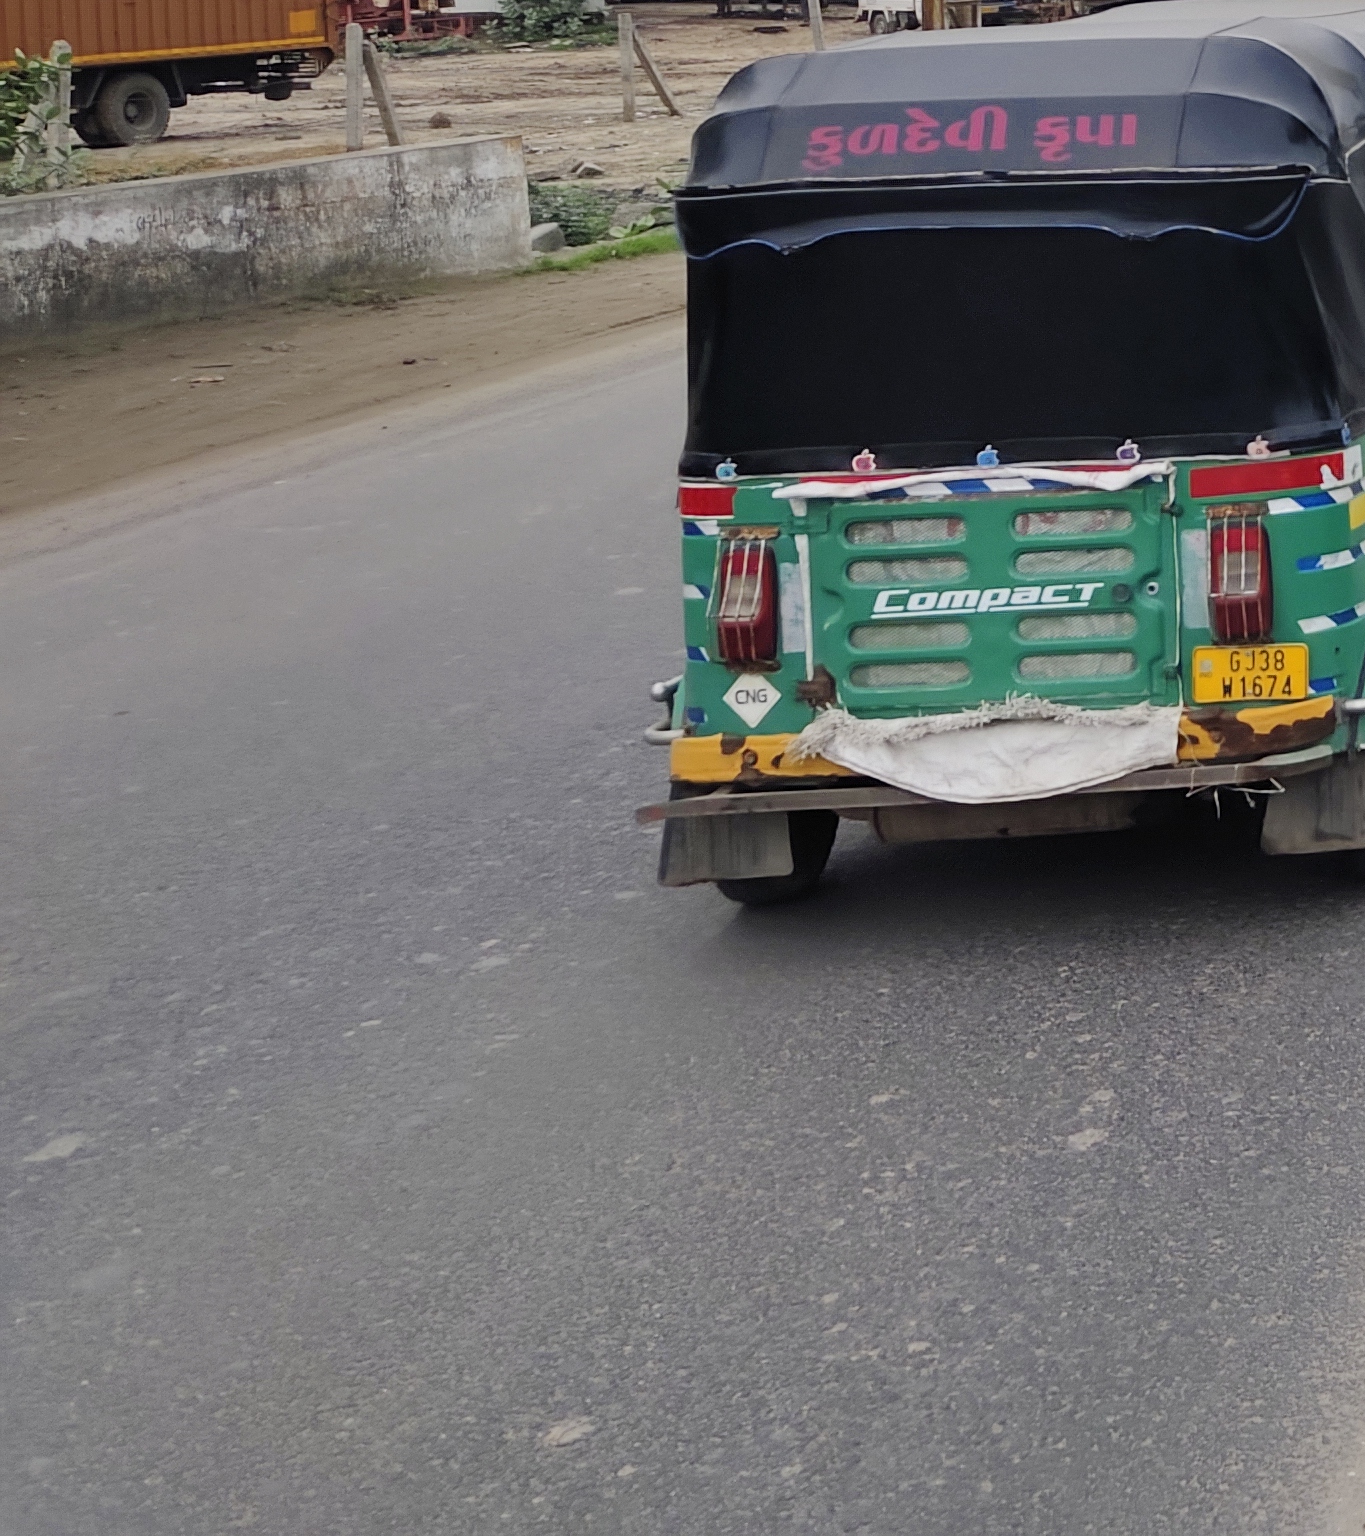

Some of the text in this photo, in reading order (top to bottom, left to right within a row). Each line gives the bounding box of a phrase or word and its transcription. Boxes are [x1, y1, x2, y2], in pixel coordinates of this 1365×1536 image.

[801, 104, 1009, 172] કુળદેવી
[1230, 649, 1285, 673] GJ38
[735, 688, 768, 705] CNG
[1222, 674, 1293, 698] W1674
